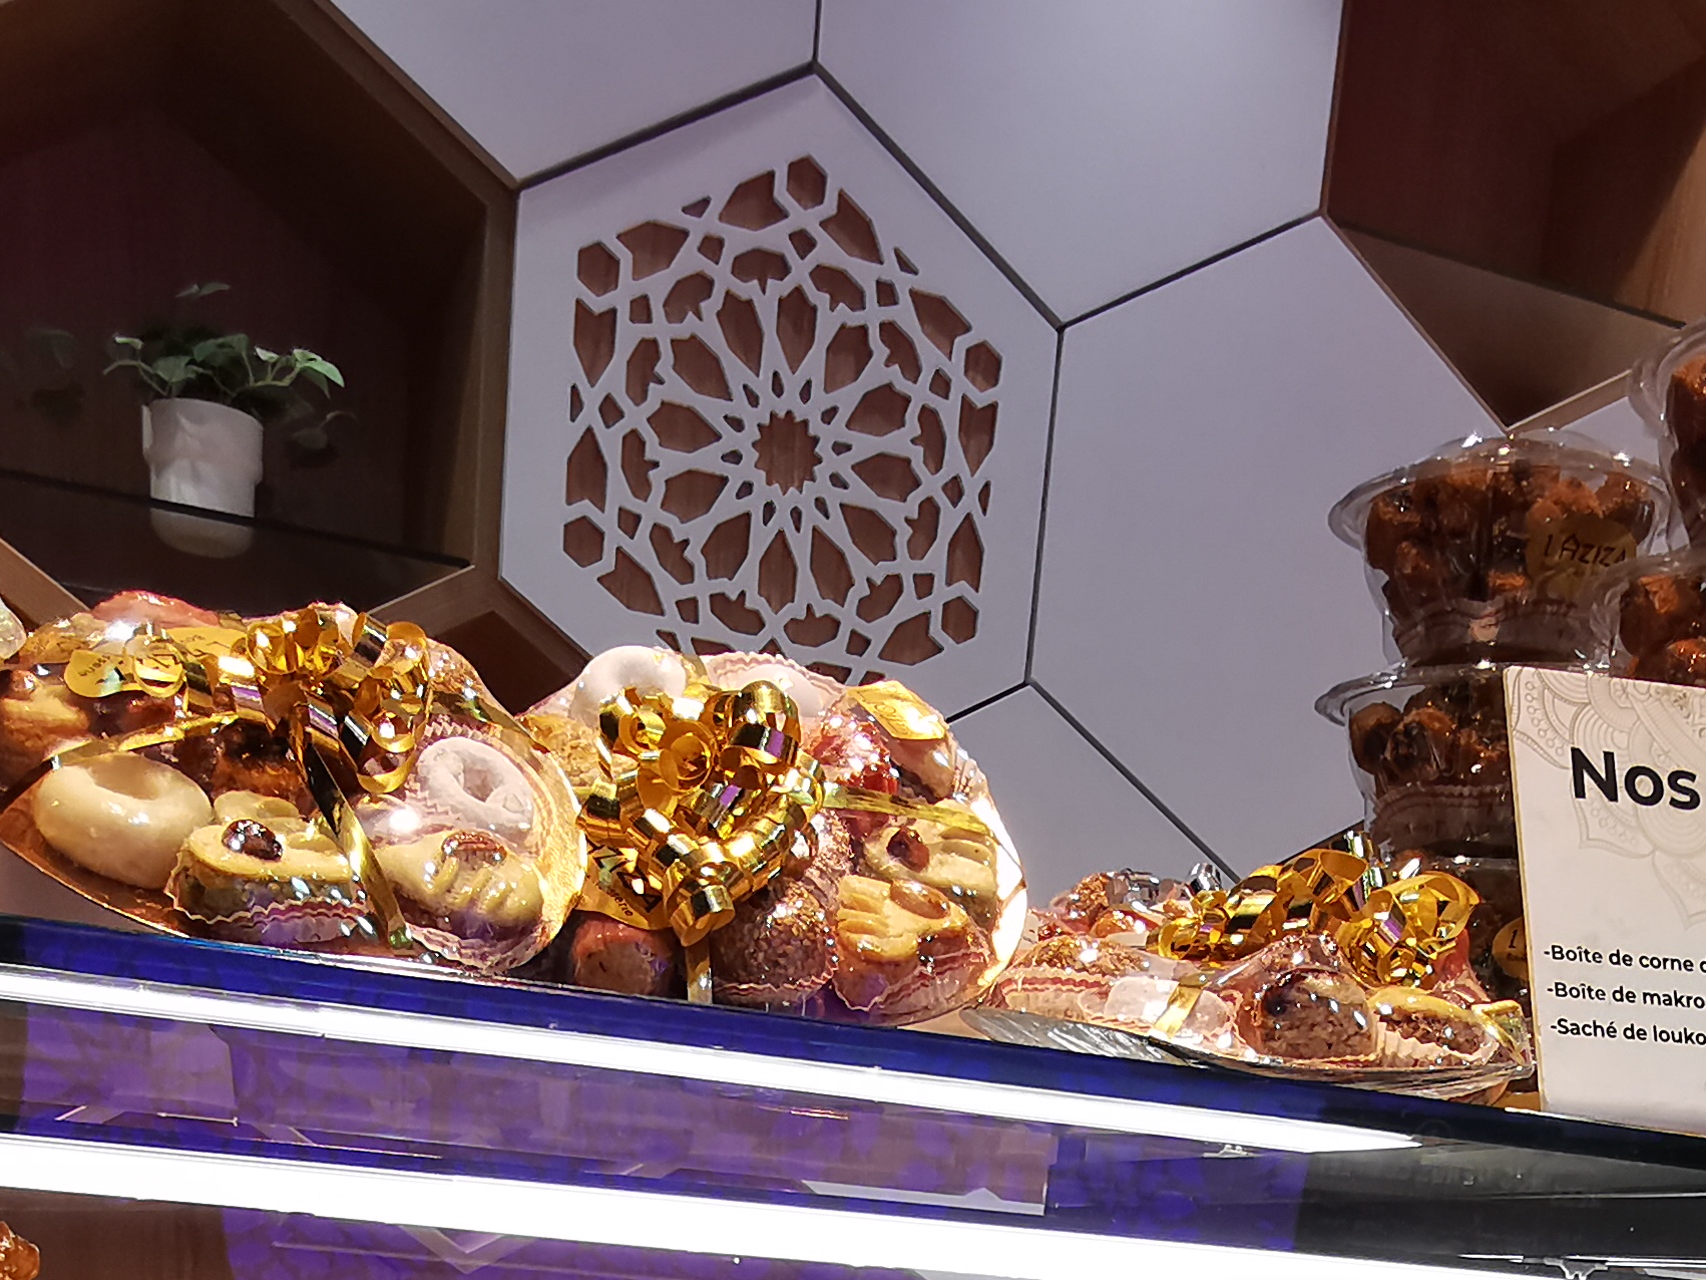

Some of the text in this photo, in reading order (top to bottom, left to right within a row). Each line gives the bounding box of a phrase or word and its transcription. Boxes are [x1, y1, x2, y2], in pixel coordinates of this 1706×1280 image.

[1570, 746, 1702, 811] Nos
[1608, 949, 1634, 967] de
[1638, 954, 1695, 972] corne
[1611, 985, 1637, 1004] de
[1622, 1022, 1648, 1041] de
